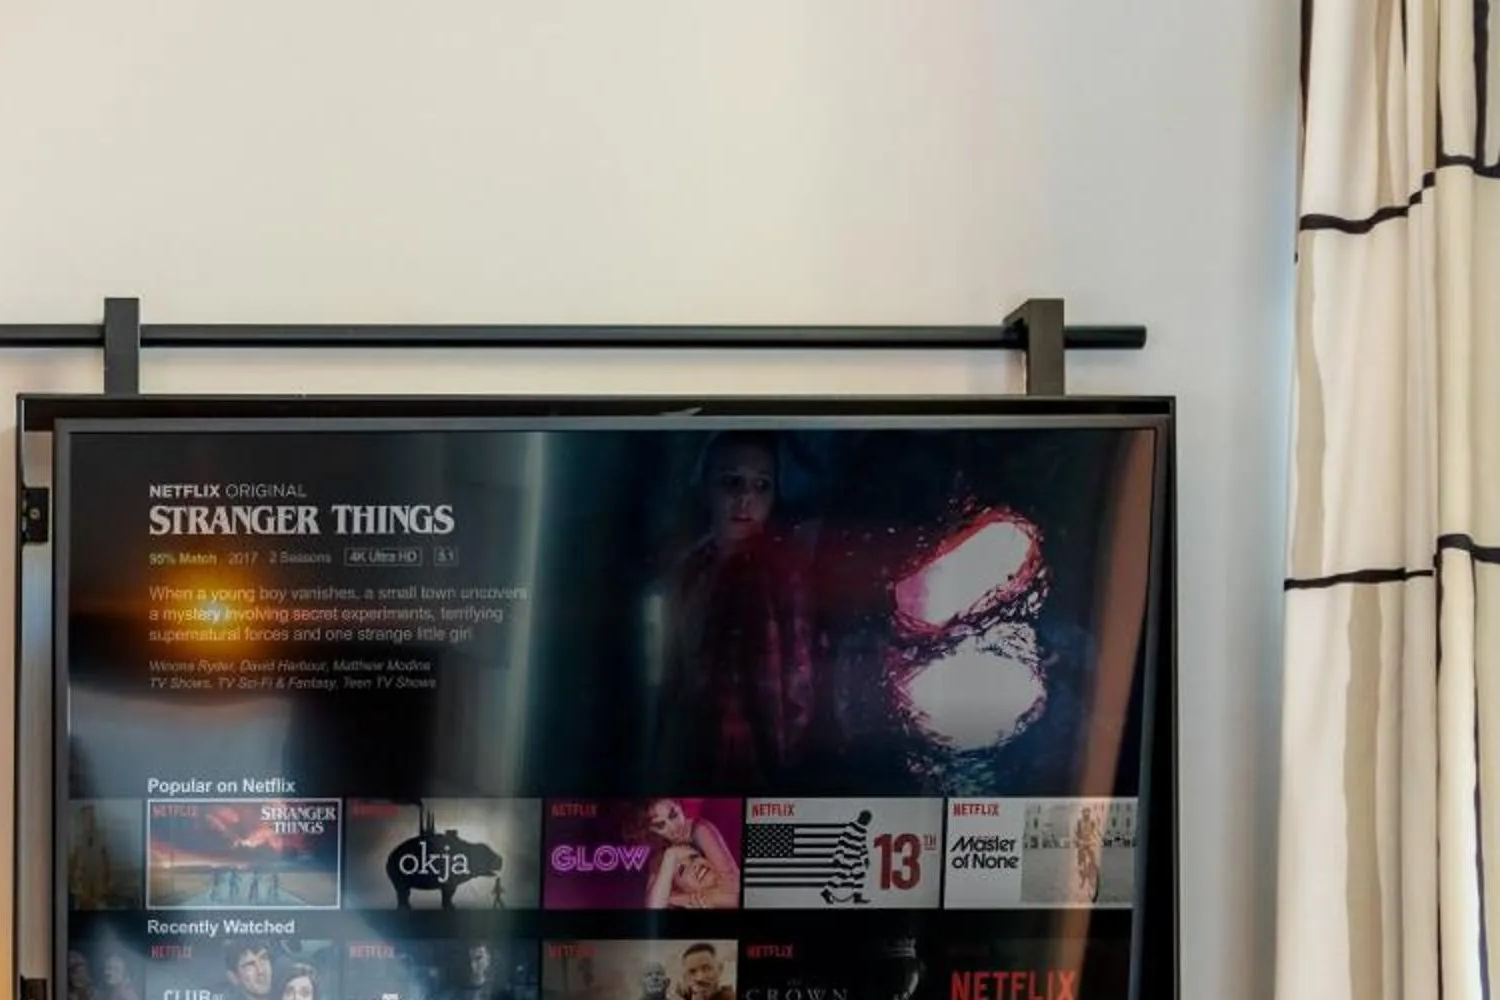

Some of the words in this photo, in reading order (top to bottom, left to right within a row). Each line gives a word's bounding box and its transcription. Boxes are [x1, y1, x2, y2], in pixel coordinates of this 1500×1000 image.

[149, 484, 220, 498] NETFLIX
[225, 484, 307, 498] ORIGINAL
[149, 504, 321, 535] STRANGER
[331, 504, 455, 535] THINGS
[179, 552, 217, 565] Match
[228, 552, 258, 565] 2017
[280, 552, 332, 565] Seasons
[149, 586, 193, 601] When
[197, 589, 207, 600] a
[211, 589, 256, 604] young
[259, 587, 286, 603] boy
[365, 590, 374, 600] a
[378, 586, 417, 600] small
[421, 588, 457, 600] town
[461, 589, 528, 600] uncovers
[149, 610, 158, 621] a
[292, 607, 338, 621] secret
[441, 606, 504, 623] terrifying
[149, 628, 240, 644] supernatural
[245, 627, 289, 641] forces
[293, 627, 321, 641] and
[325, 630, 353, 641] one
[357, 629, 413, 645] strange
[417, 627, 445, 641] little
[148, 777, 212, 796] Popular
[217, 782, 237, 793] on
[243, 777, 296, 793] Netflix
[260, 806, 337, 821] STRANGER
[552, 804, 597, 817] NETFLIX
[752, 804, 795, 818] NETFLIX
[953, 803, 999, 816] NETFLIX
[273, 821, 324, 835] THINGS
[950, 836, 1016, 852] Master
[399, 841, 470, 881] okja
[551, 845, 650, 871] GLOW
[952, 854, 969, 869] of
[973, 854, 1019, 869] None
[148, 919, 219, 937] Recently
[223, 919, 295, 934] Watched
